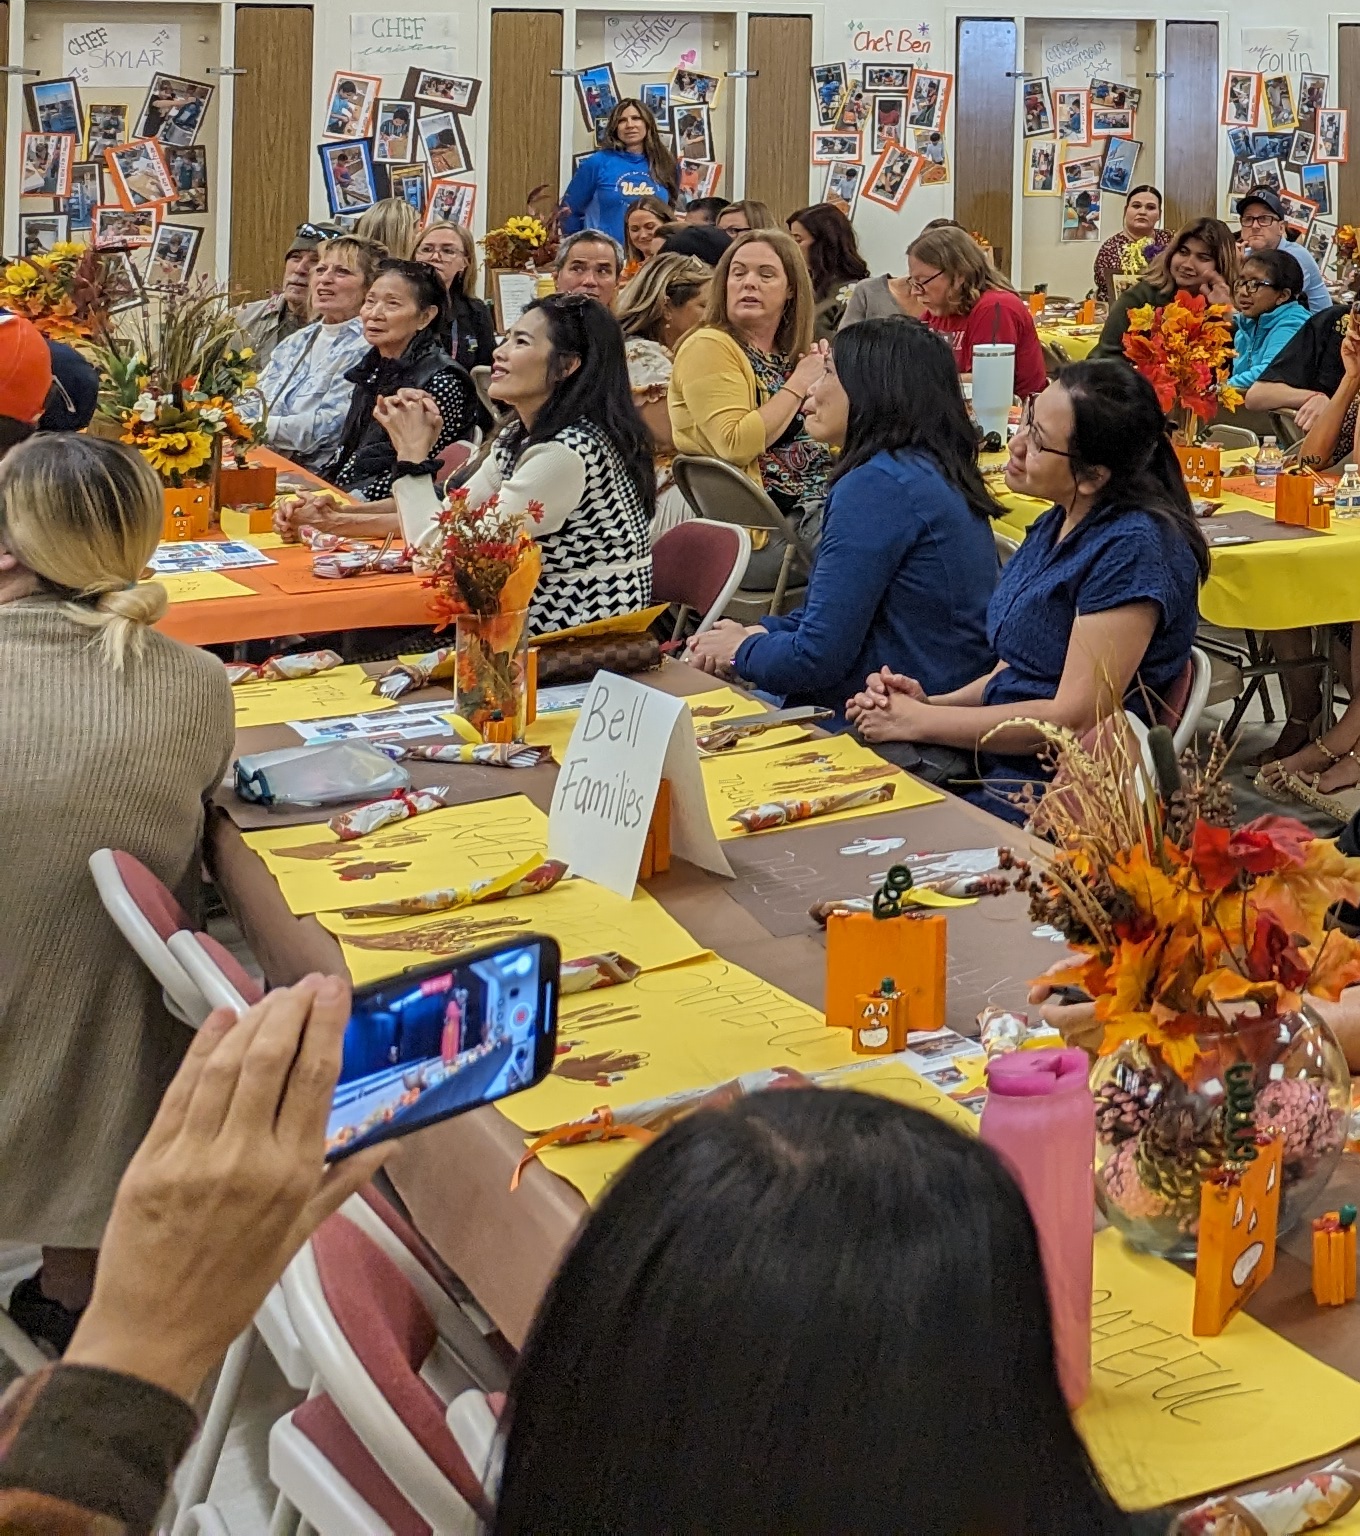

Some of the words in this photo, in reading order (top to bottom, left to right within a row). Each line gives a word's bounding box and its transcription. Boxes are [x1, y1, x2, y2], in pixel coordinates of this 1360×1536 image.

[67, 27, 109, 56] CHEF
[371, 17, 427, 40] CHEF
[613, 15, 652, 51] CHEF
[622, 15, 677, 68] JASMINE
[853, 29, 894, 52] Chef
[896, 29, 931, 53] Ben
[88, 48, 164, 69] SKYLAR
[1045, 36, 1079, 63] CHEF
[1046, 40, 1106, 84] JONATHAN
[583, 685, 648, 748] Bell
[559, 757, 644, 828] Families
